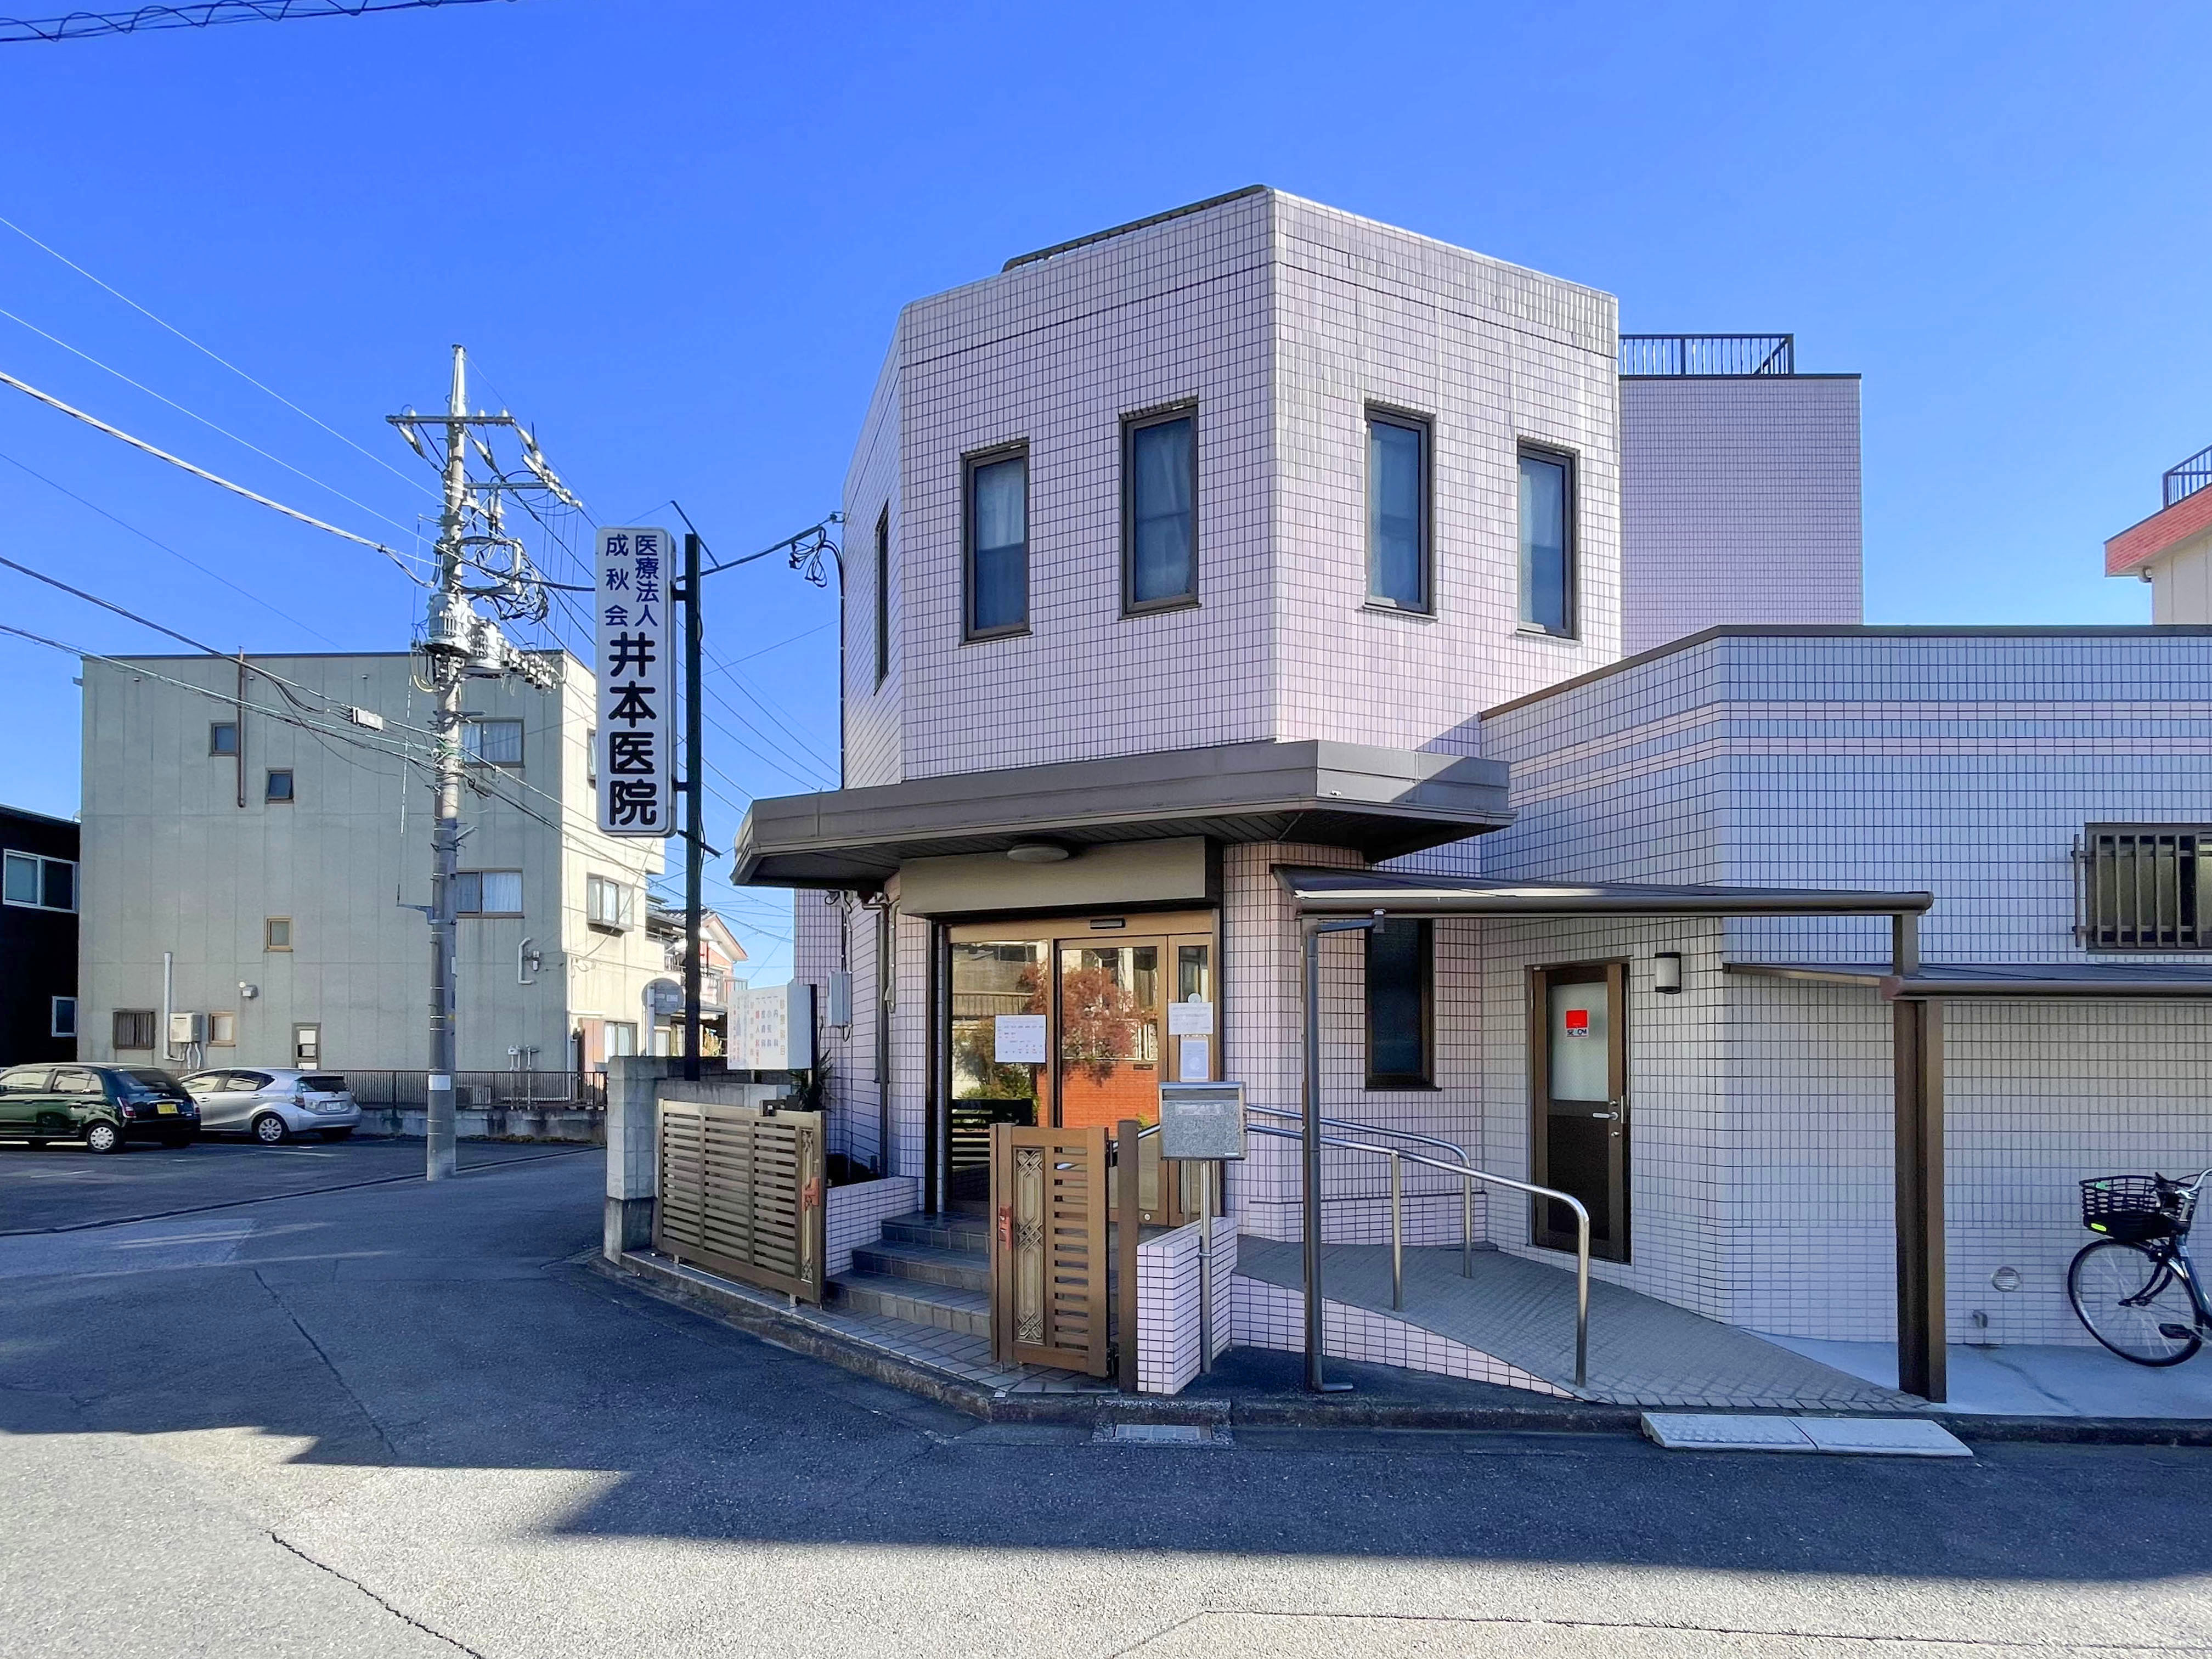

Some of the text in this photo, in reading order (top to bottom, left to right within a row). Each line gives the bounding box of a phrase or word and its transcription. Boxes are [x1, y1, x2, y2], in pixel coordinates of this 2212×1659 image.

[604, 534, 629, 627] 成秋会
[635, 534, 659, 628] 医療法人
[608, 631, 657, 826] 井本医院
